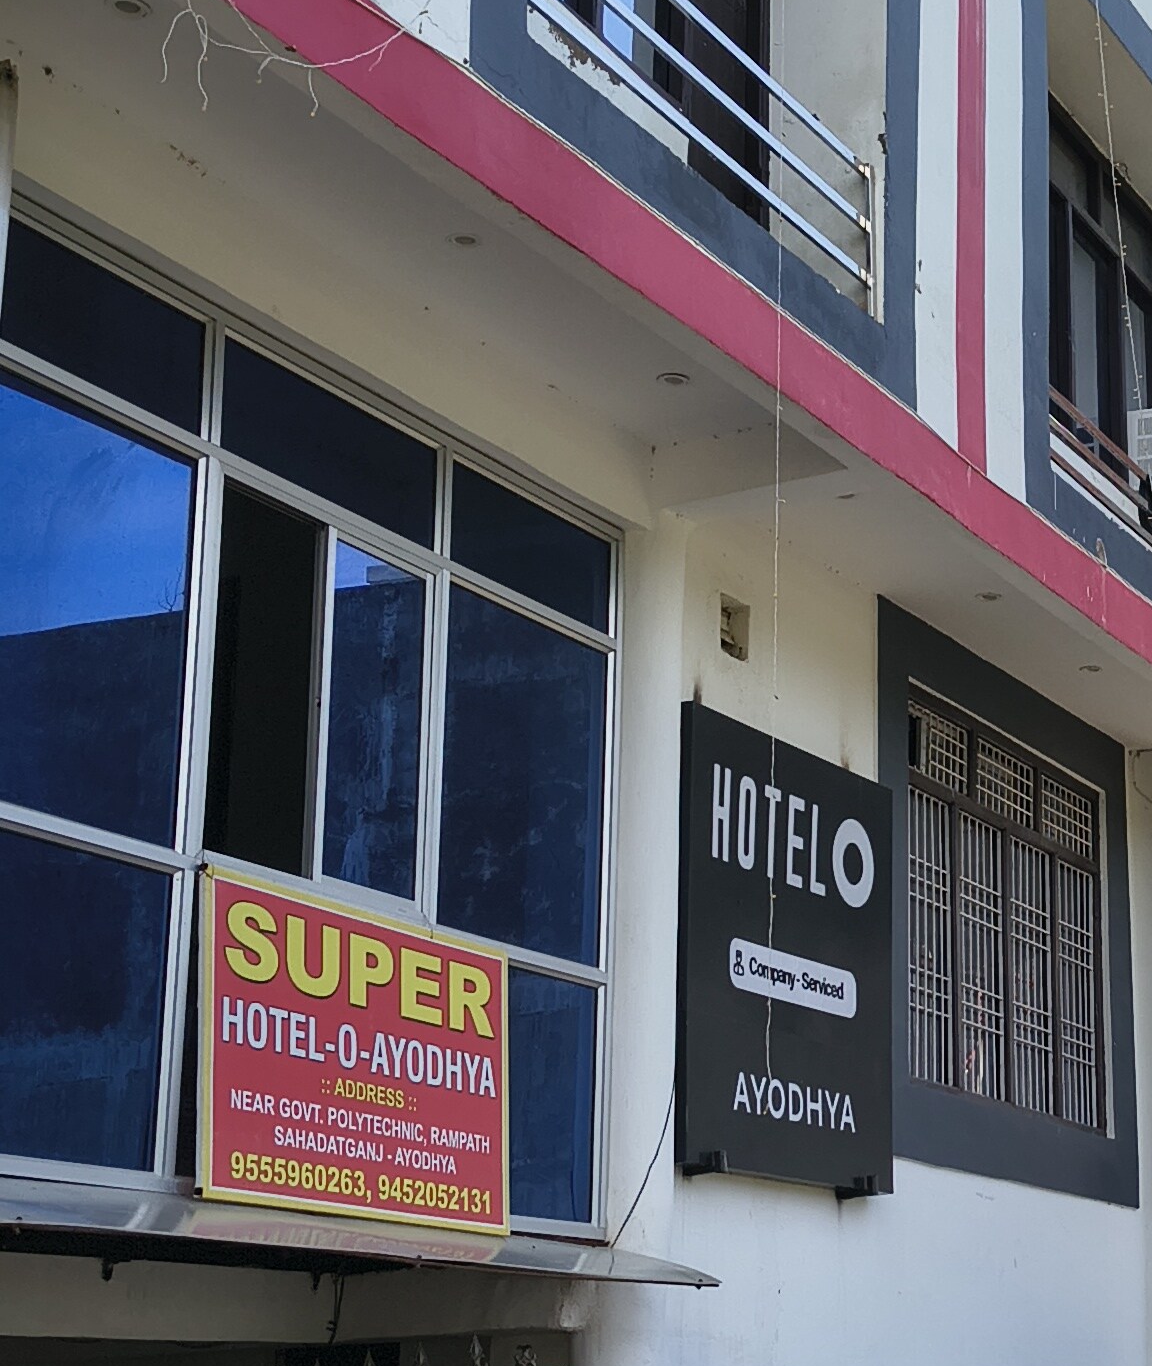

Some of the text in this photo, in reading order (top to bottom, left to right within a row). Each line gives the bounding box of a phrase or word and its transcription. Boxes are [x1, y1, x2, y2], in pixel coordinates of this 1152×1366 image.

[712, 763, 874, 908] HOTEL O
[224, 901, 494, 1038] SUPER
[222, 996, 496, 1098] HOTEL-O-AYODHYA
[230, 1088, 490, 1154] NEAR GOVT. POLYTECHNIC, RAMPATH
[334, 1078, 405, 1109] ADDRESS
[733, 1072, 856, 1133] AYODHYA
[230, 1150, 491, 1215] 9555960263, 9452052131
[274, 1125, 384, 1162] SAHADATGANJ
[394, 1146, 457, 1175] AYODHYA
